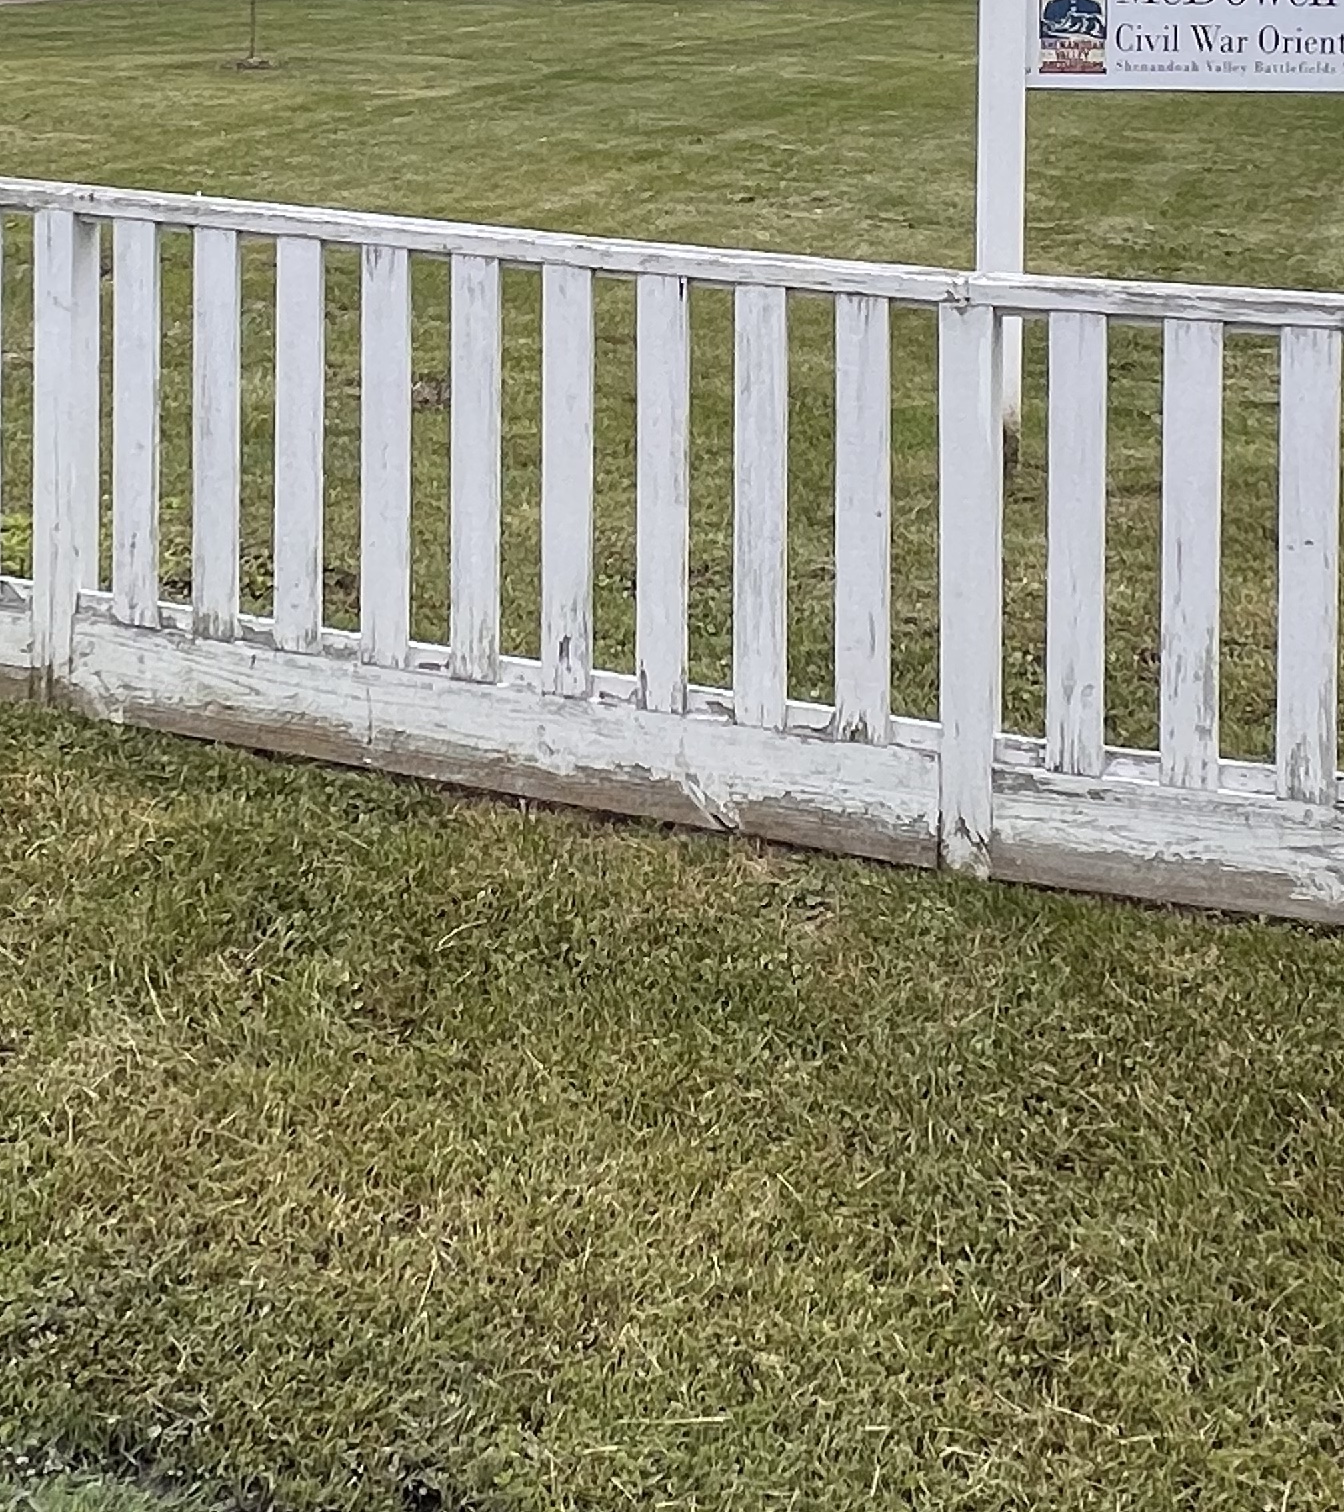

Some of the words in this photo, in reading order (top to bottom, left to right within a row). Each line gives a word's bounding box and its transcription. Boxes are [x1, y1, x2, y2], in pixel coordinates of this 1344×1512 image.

[1115, 23, 1180, 53] Civil
[1191, 24, 1248, 54] War
[1115, 60, 1200, 73] Shenandoah
[1206, 60, 1247, 76] Valley
[1254, 61, 1337, 75] Battlefields
